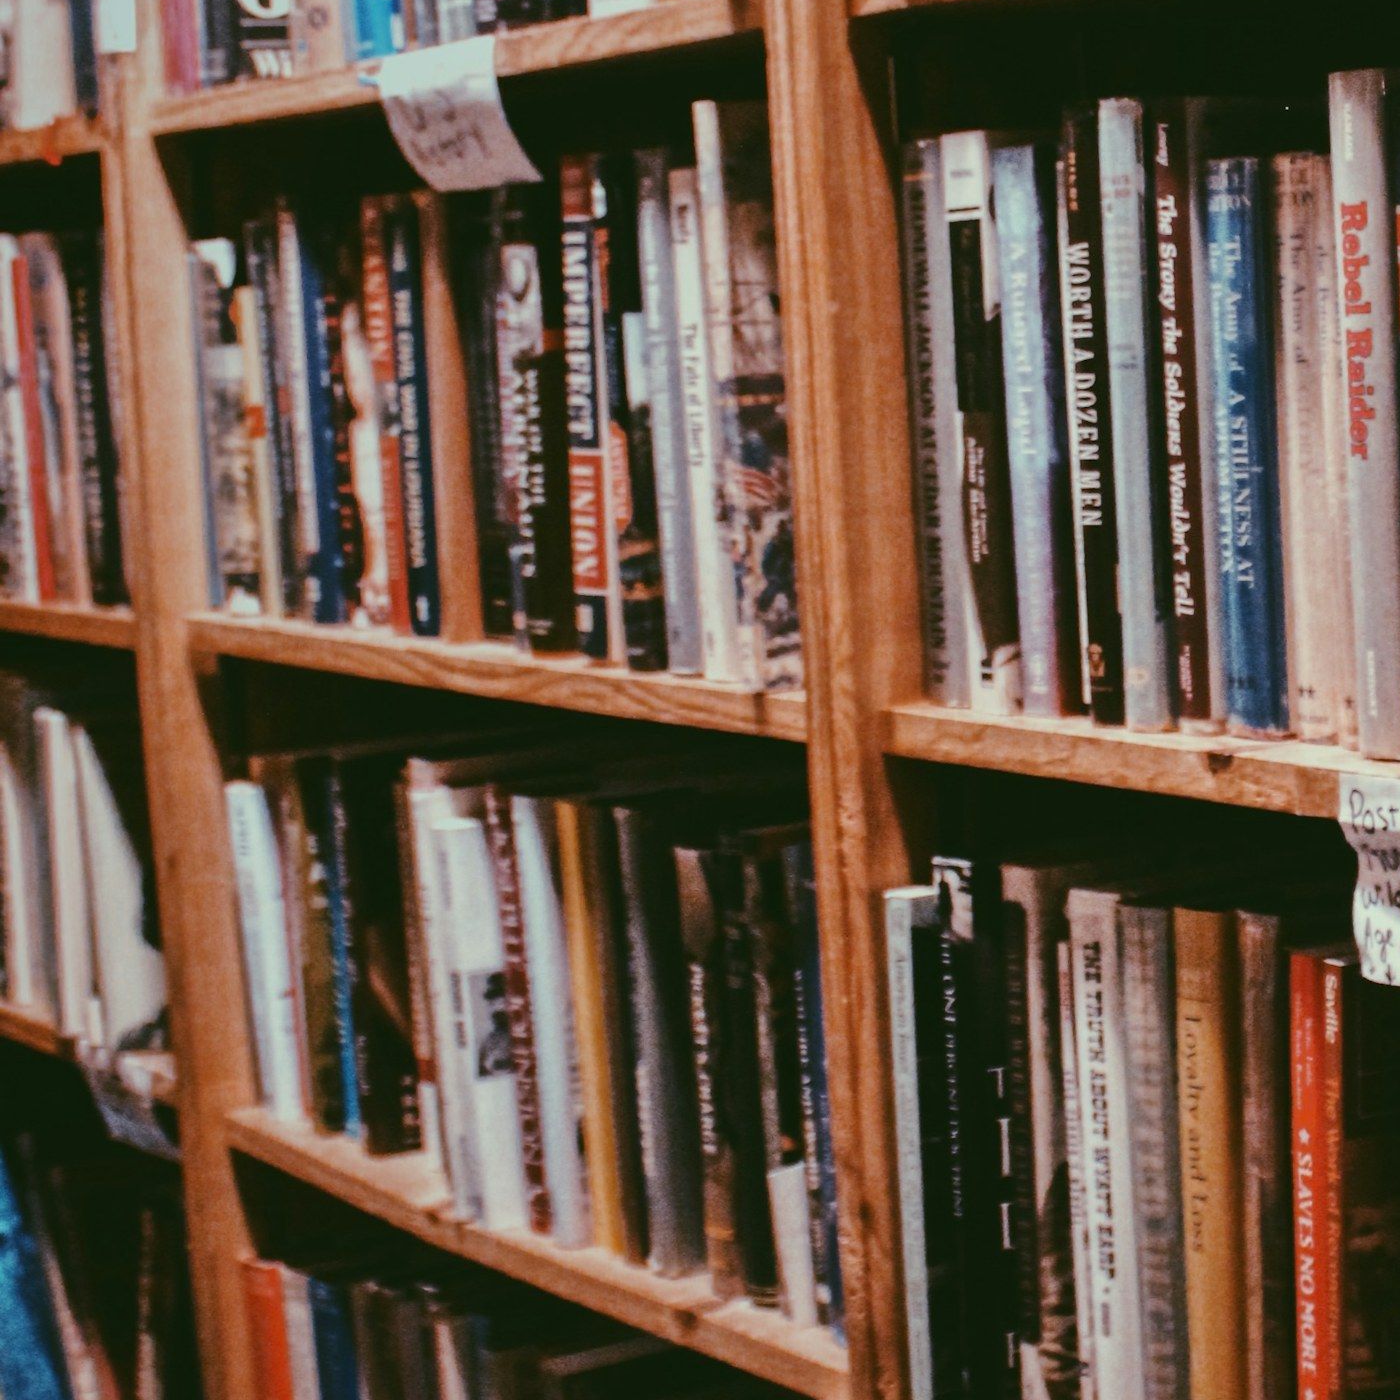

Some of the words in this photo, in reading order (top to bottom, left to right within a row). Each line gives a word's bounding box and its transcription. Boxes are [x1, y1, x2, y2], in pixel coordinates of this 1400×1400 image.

[1067, 241, 1096, 340] WORTH
[1341, 202, 1372, 315] Rebel
[561, 230, 594, 441] IMPERFECT
[1070, 348, 1094, 367] A
[1073, 372, 1100, 461] DOZEN
[1347, 327, 1376, 461] Raider
[570, 463, 599, 579] UNION
[1079, 468, 1103, 526] MEN
[1350, 788, 1399, 835] Post
[1084, 941, 1101, 984] THE
[1086, 990, 1104, 1063] TRUTH
[1091, 1070, 1110, 1139] ABOUT
[1298, 1153, 1314, 1248] SLAVES
[1098, 1224, 1116, 1279] EARP
[1300, 1255, 1315, 1295] NO
[1301, 1300, 1316, 1375] MORE
